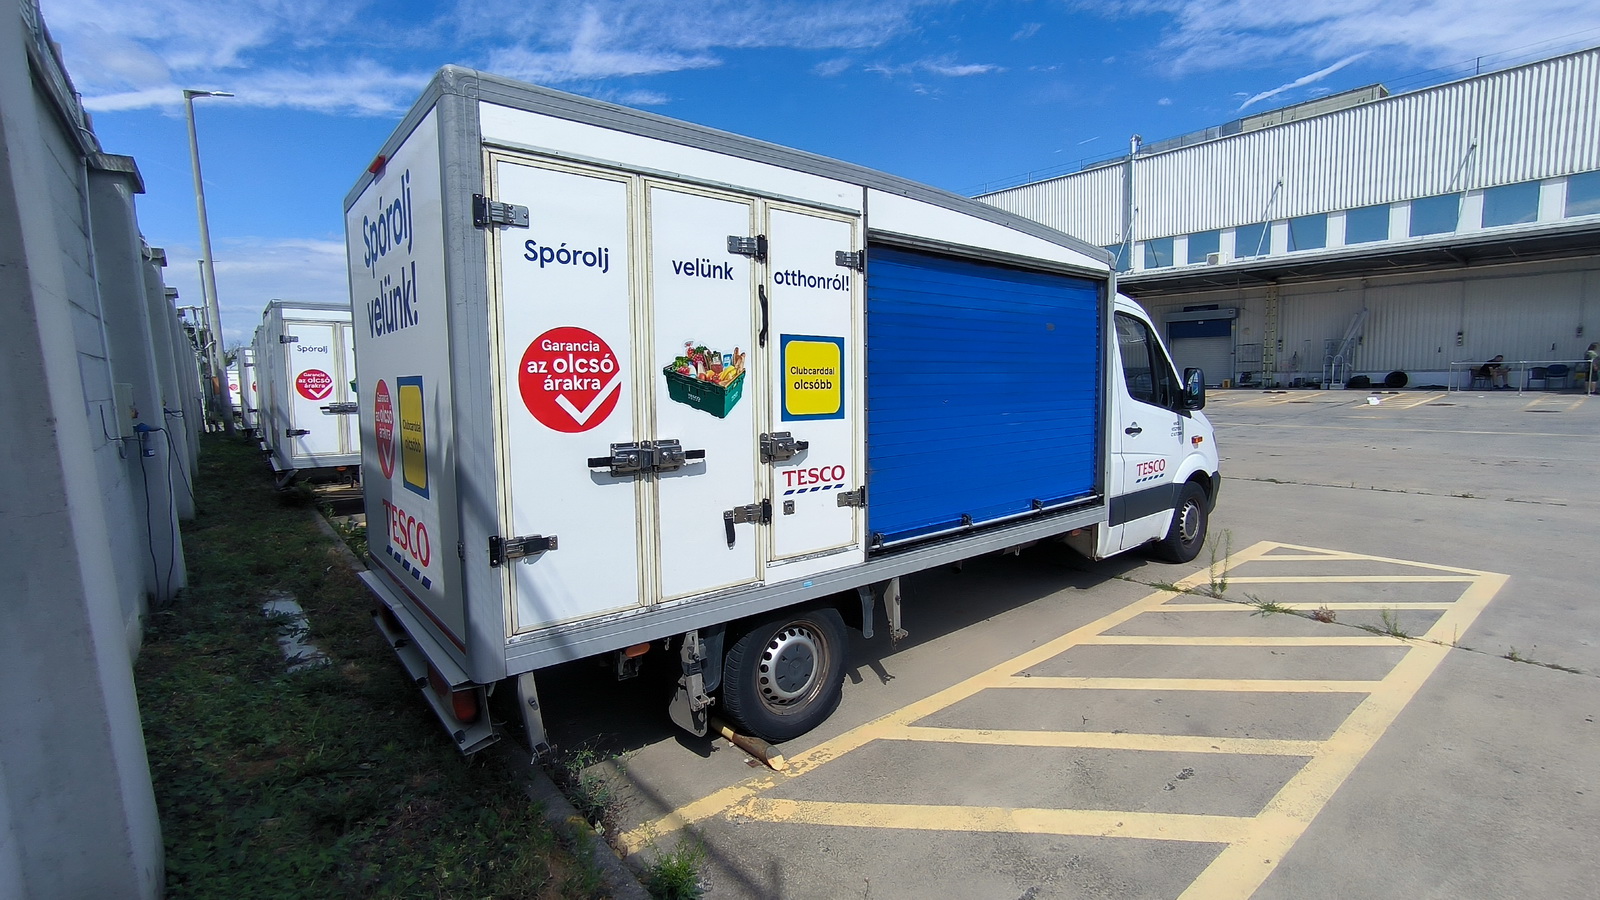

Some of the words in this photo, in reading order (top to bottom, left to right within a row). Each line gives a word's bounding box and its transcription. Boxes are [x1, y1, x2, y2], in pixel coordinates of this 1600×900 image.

[363, 169, 414, 278] Spórolj
[523, 239, 610, 274] Spórolj
[672, 257, 734, 281] velünk
[774, 269, 850, 292] otthonról!
[366, 261, 419, 338] velünk!
[297, 345, 328, 354] Spórolj
[541, 340, 600, 353] Garancia
[527, 360, 548, 374] az
[553, 352, 614, 374] olcsó
[790, 366, 835, 375] Clubcarddal
[543, 374, 601, 391] árakra
[793, 378, 832, 390] olcsóbb
[379, 405, 393, 425] olcsó
[405, 437, 421, 454] olcsóbb
[782, 464, 845, 487] TESCO
[1136, 459, 1166, 476] TESCO
[382, 498, 431, 568] TESCO
